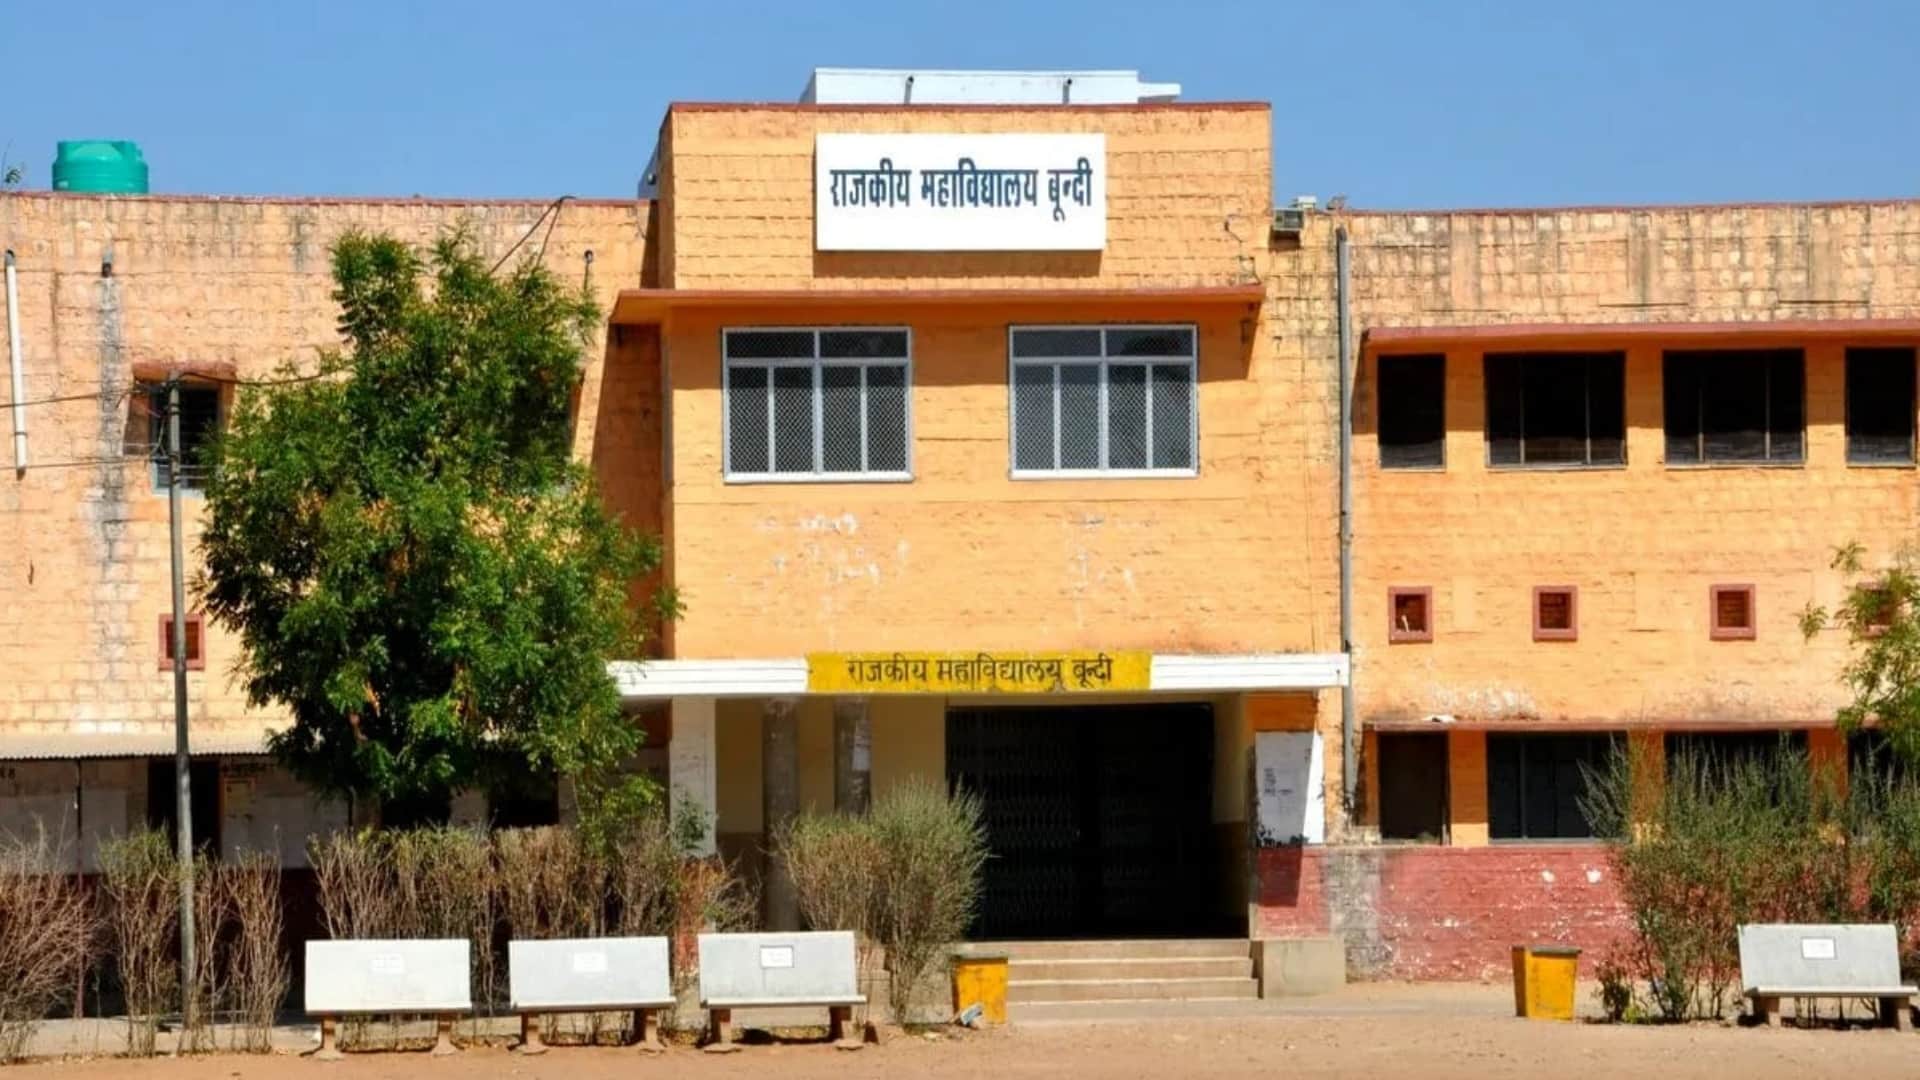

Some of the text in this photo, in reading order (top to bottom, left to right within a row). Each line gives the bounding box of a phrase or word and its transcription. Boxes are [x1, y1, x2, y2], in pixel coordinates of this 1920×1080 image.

[829, 156, 1093, 222] राजकीय महाविद्यालय बून्दी
[847, 652, 928, 683] राजकीय
[936, 652, 1063, 687] महाविद्यालय
